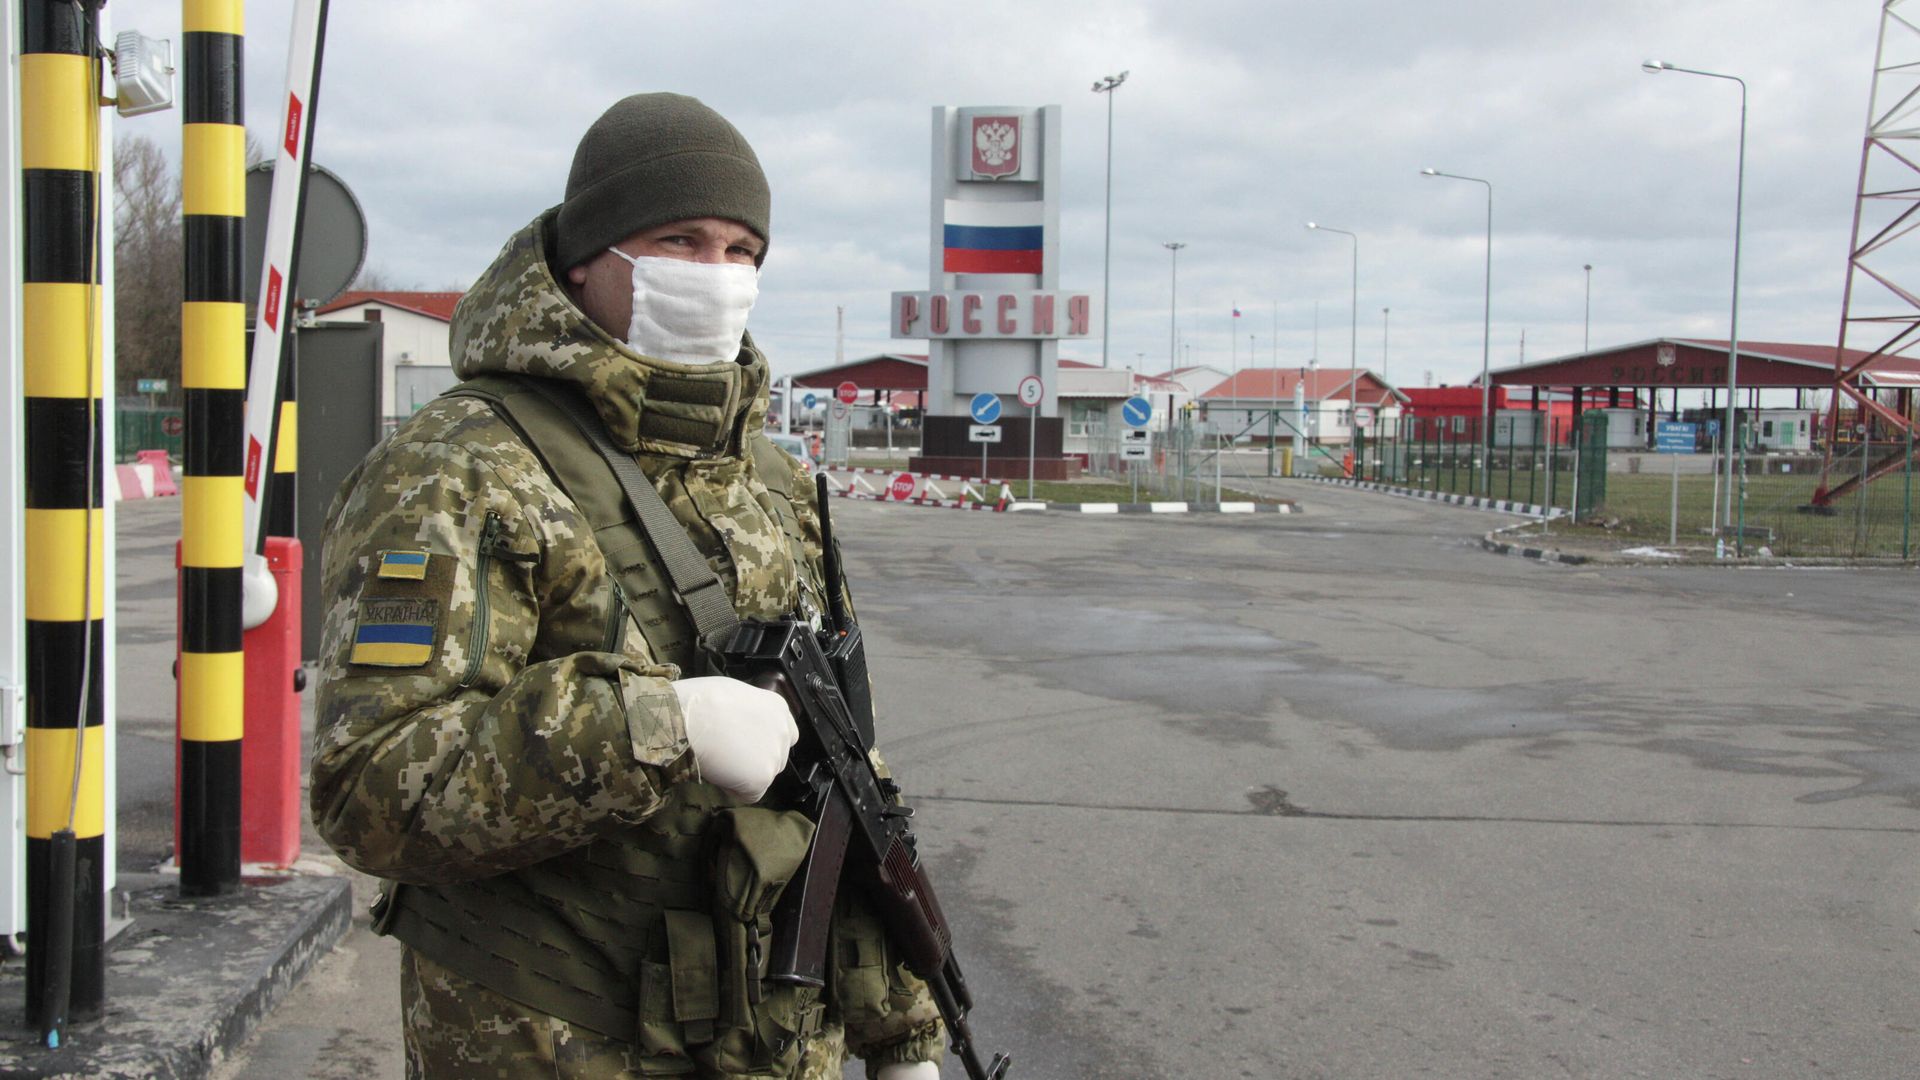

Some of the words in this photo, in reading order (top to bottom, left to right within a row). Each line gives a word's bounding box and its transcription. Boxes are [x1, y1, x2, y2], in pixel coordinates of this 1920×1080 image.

[901, 294, 1090, 336] РОССИЯ
[1612, 366, 1727, 384] РОССИЯ
[840, 389, 857, 398] STOP
[1027, 385, 1035, 398] 5
[894, 482, 914, 492] STOP
